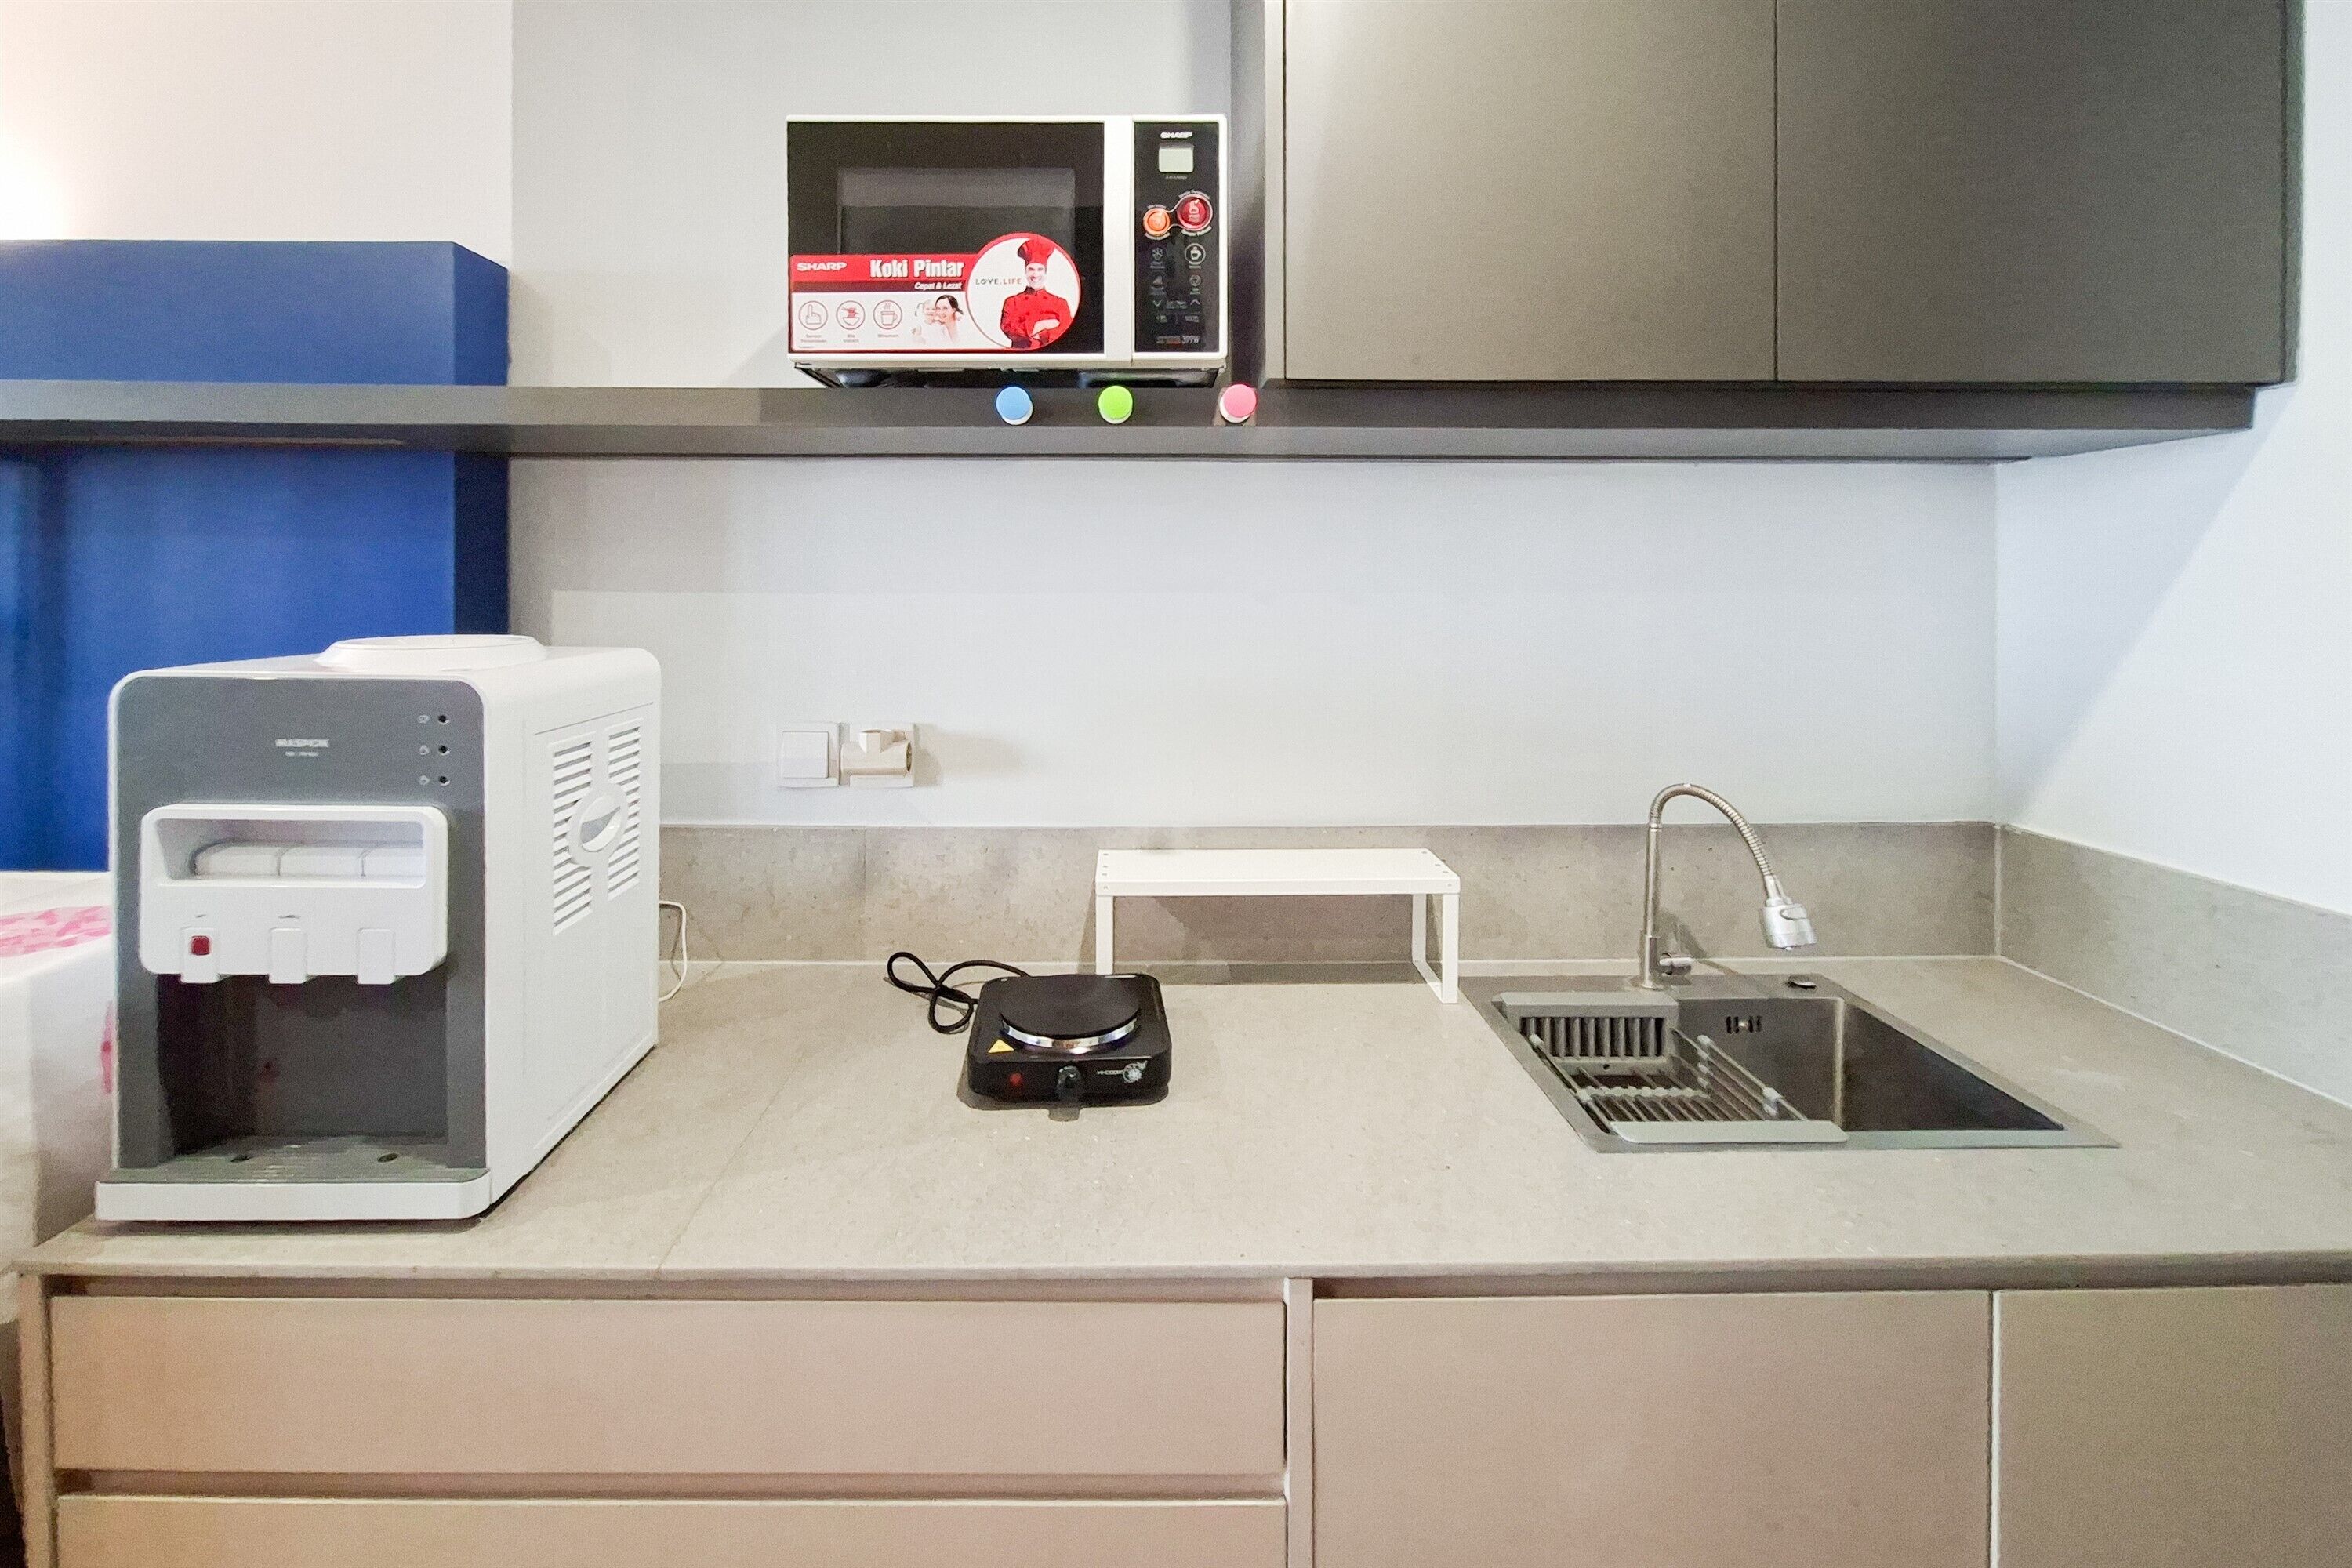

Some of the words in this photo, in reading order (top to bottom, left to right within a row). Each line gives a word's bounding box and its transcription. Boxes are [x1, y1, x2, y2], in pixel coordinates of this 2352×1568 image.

[796, 262, 848, 272] SHARP
[869, 260, 908, 278] Koki
[913, 260, 964, 278] Pintar
